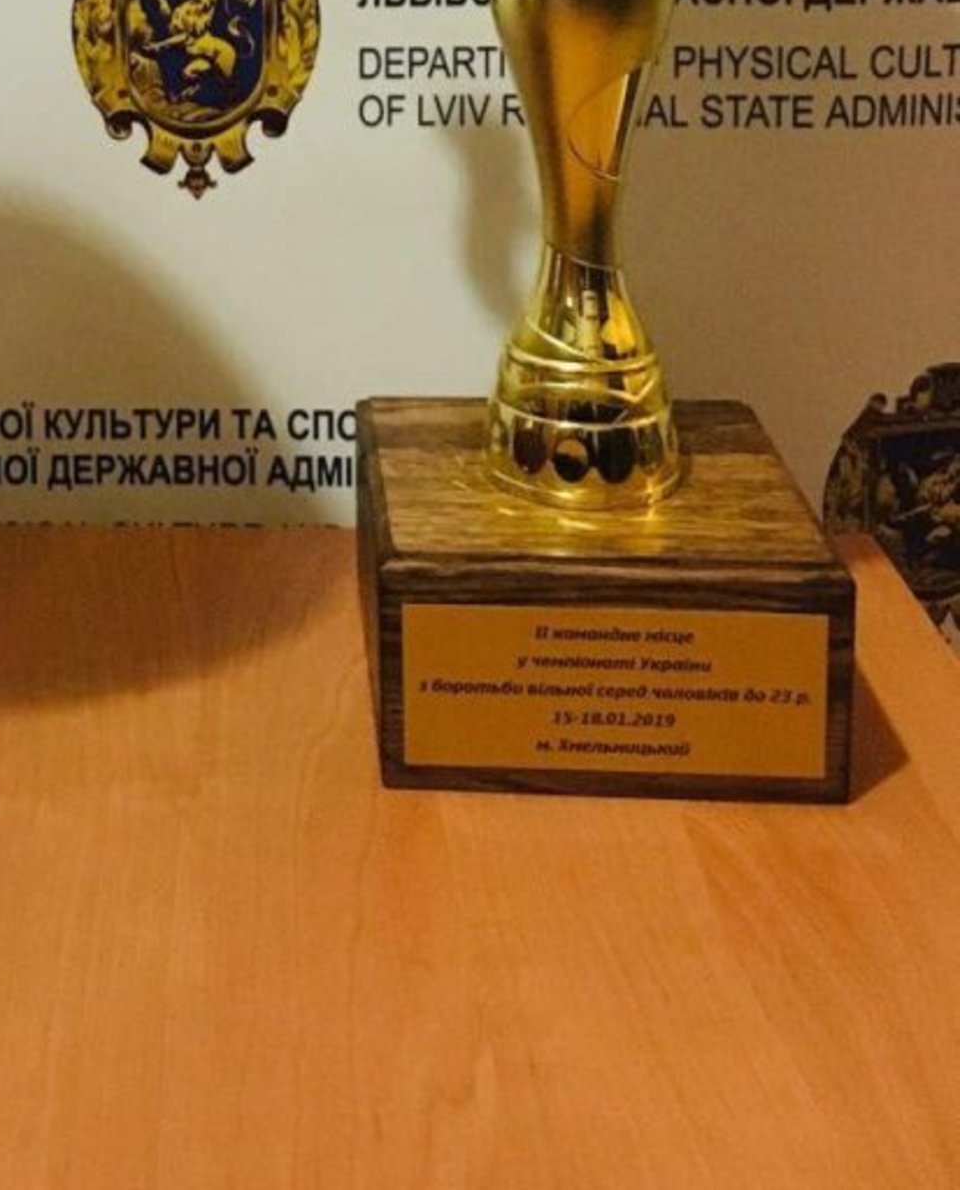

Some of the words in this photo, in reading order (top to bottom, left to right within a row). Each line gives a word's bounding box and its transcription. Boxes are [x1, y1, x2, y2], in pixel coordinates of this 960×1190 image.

[674, 45, 857, 80] PHYSICAL
[358, 94, 406, 128] OF
[417, 94, 491, 127] LVIV
[701, 94, 814, 129] STATE
[44, 407, 220, 441] КУЛЬТУРИ
[231, 408, 277, 440] ТА
[47, 446, 258, 489] ДЕРЖАВНОЇ
[552, 712, 676, 728] 15-18.01.2019
